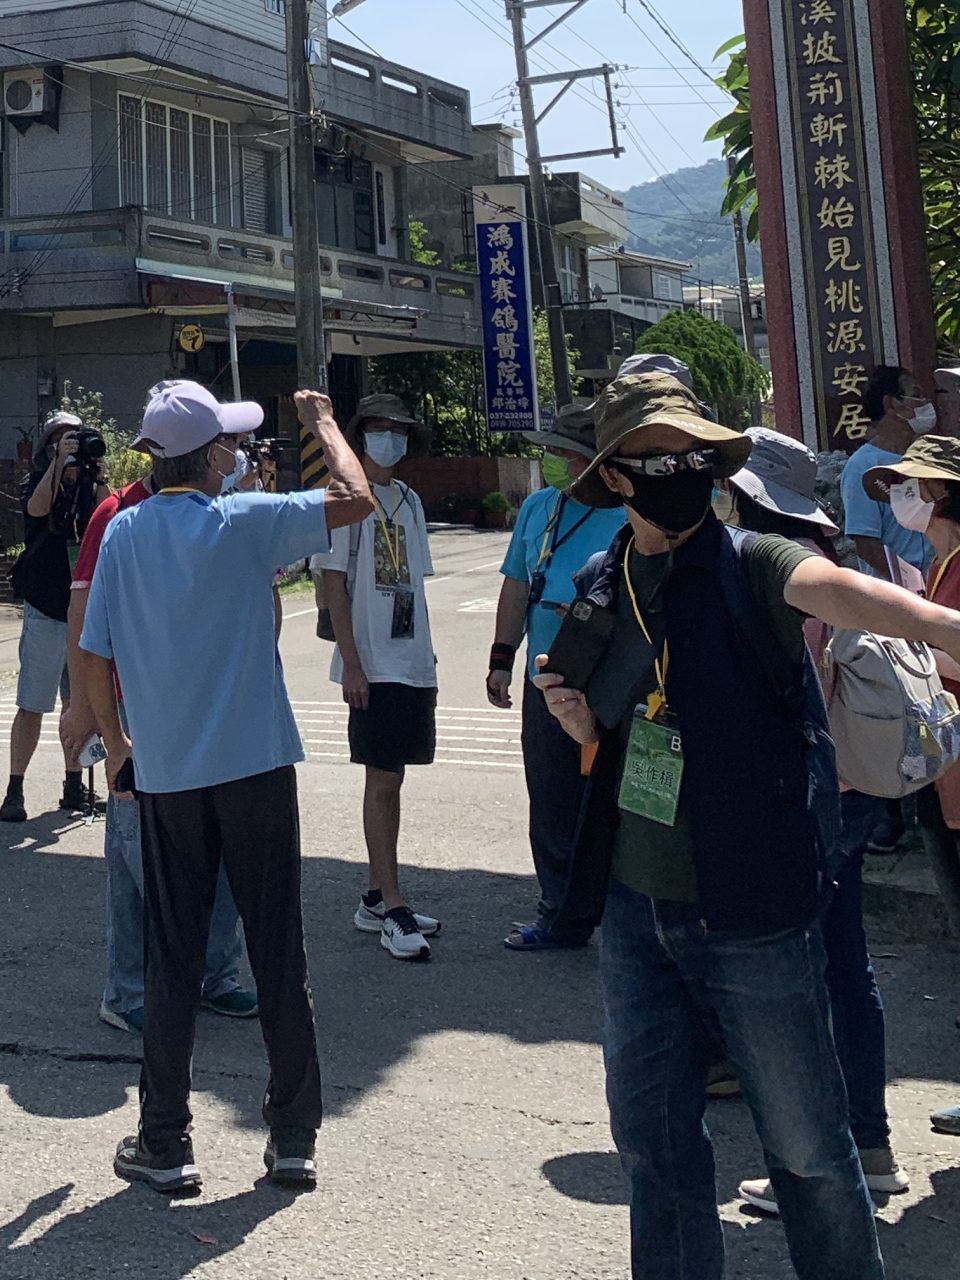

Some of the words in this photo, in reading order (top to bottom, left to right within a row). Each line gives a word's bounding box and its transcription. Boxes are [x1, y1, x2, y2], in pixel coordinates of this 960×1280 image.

[486, 223, 524, 387] 鴻成賽鴿醫院
[671, 735, 682, 752] B
